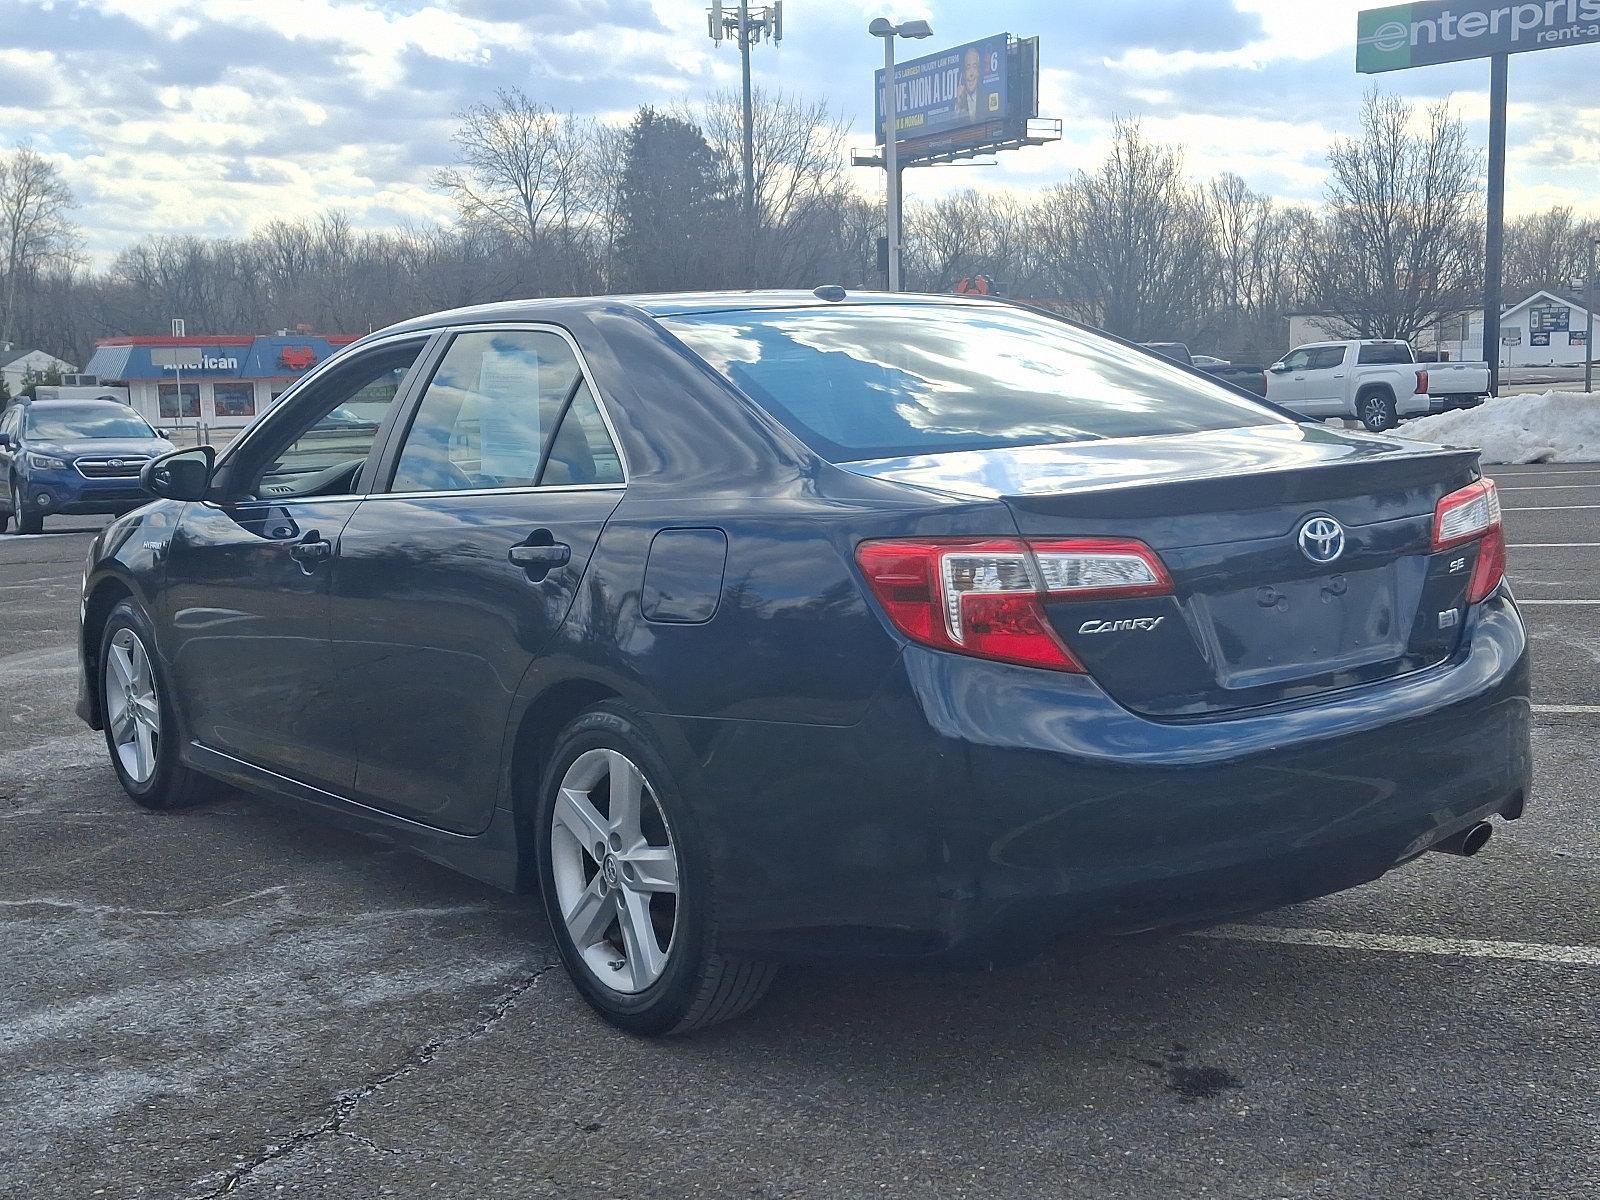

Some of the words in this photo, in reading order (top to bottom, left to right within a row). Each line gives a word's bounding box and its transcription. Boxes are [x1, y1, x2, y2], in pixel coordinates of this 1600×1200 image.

[879, 83, 908, 116] WVE
[909, 76, 932, 109] WON
[933, 73, 941, 104] A
[942, 68, 960, 101] LOT
[1449, 557, 1465, 574] SE
[1078, 616, 1164, 635] CAMRY
